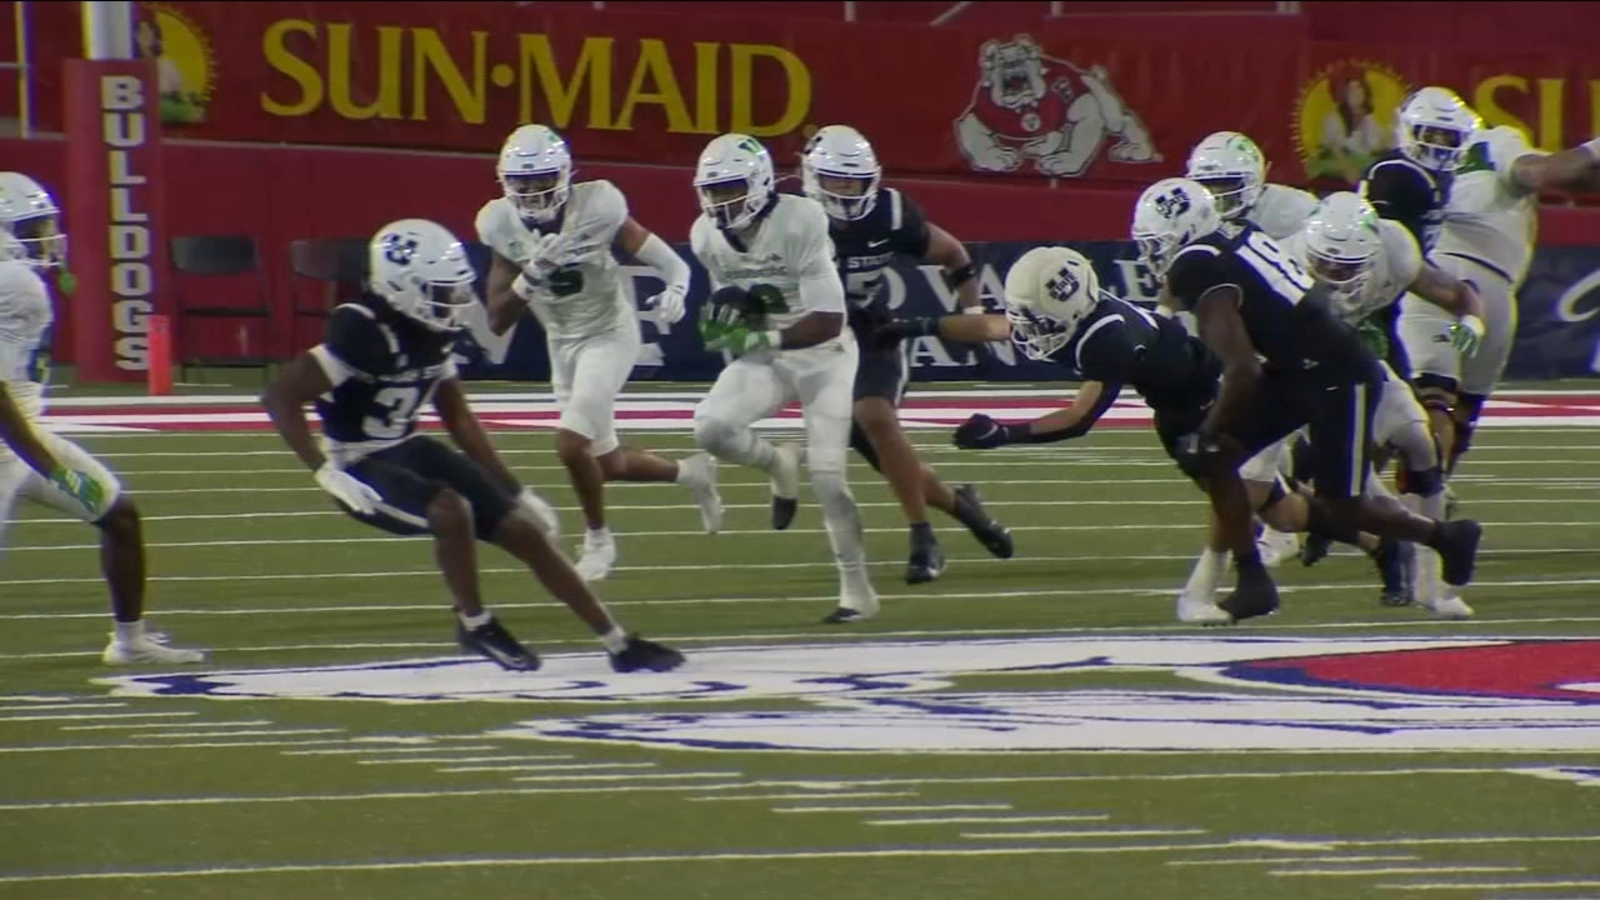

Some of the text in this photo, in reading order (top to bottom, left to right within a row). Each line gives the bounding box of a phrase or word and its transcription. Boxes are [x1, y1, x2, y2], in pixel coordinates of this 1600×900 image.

[101, 75, 151, 370] BULLDOGS
[1235, 231, 1316, 306] 18
[361, 386, 419, 438] 3
